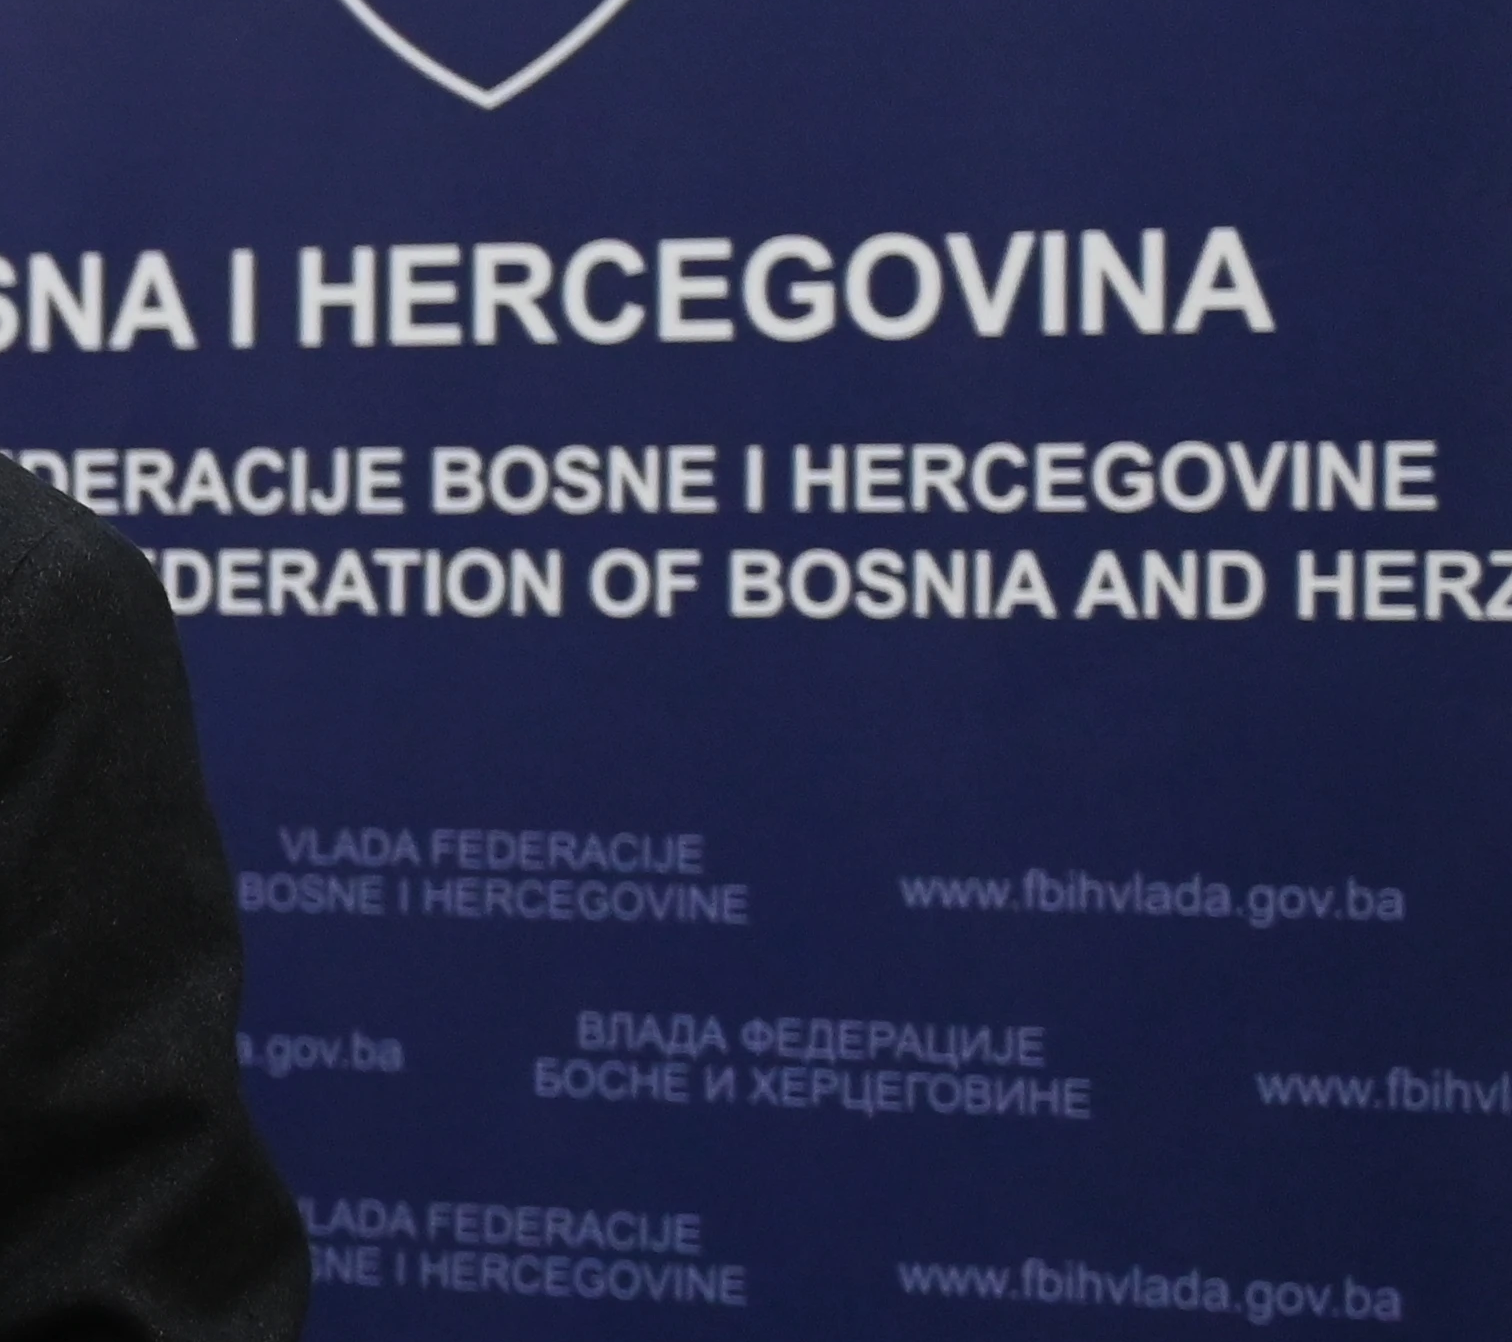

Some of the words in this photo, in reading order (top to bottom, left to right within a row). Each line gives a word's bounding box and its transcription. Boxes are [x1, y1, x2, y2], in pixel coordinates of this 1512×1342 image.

[227, 246, 258, 351] I
[299, 226, 1275, 348] HERCEGOVINA
[0, 446, 405, 516] DERACIJE
[432, 445, 718, 515] BOSNE
[742, 442, 768, 515] I
[792, 440, 1438, 513] HERCEGOVINE
[145, 548, 562, 617] DERATION
[588, 548, 701, 618] OF
[729, 548, 1058, 619] BOSNIA
[1074, 549, 1266, 620] AND
[278, 826, 422, 868] VLADA
[429, 827, 704, 875] FEDERACIJE
[236, 870, 384, 915] BOSNE
[395, 877, 413, 915] I
[422, 877, 748, 925] HERCEGOVINE
[899, 867, 1406, 929] www.fbihvlada.gov.ba
[576, 1009, 729, 1059] ВЛАДА
[739, 1016, 1045, 1069] ФЕДЕРАЦИЈЕ
[532, 1058, 689, 1104] БОСНЕ
[700, 1063, 740, 1105] И
[749, 1066, 1091, 1120] ХЕРЦЕГОВИНЕ
[426, 1201, 701, 1255] FEDERACIJE
[391, 1249, 410, 1286] I
[418, 1251, 747, 1307] HERCEGOVINE
[897, 1257, 1404, 1326] www.fbihvlada.gov.ba
